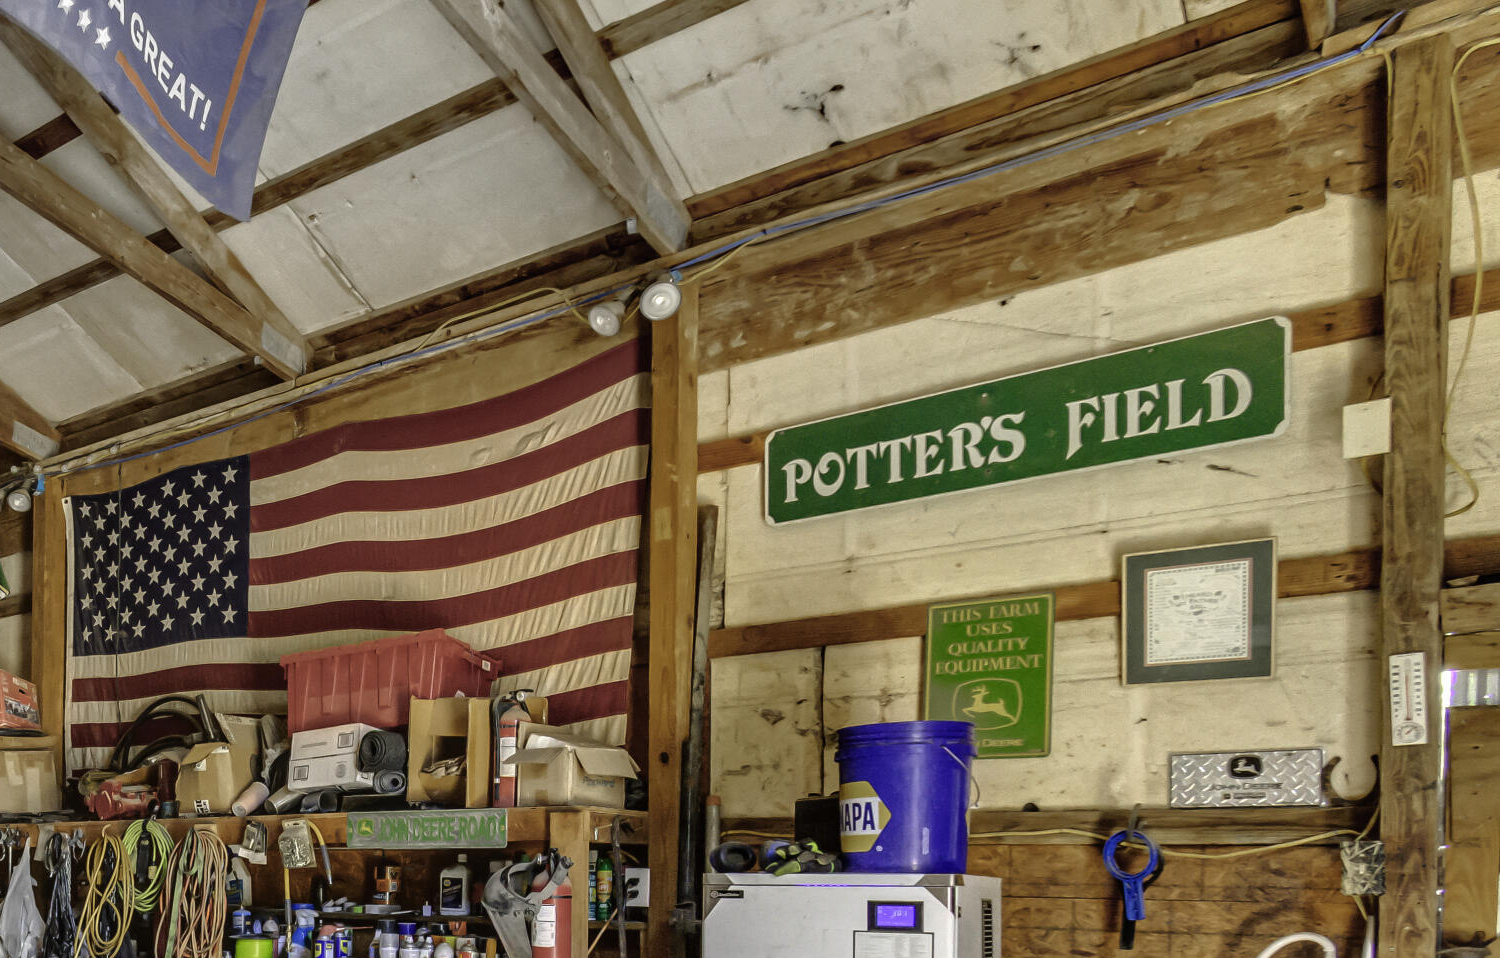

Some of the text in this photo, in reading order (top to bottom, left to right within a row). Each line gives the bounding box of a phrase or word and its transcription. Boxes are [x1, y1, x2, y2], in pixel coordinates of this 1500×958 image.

[130, 11, 212, 131] GREAT!
[781, 367, 1253, 504] POTTER'S FIELD
[941, 602, 1040, 624] THIS FARM
[966, 621, 1013, 637] USES
[948, 637, 1030, 656] QUALITY
[935, 654, 1044, 675] EQUIPMENT
[379, 815, 497, 841] JOHN DEERE ROAD
